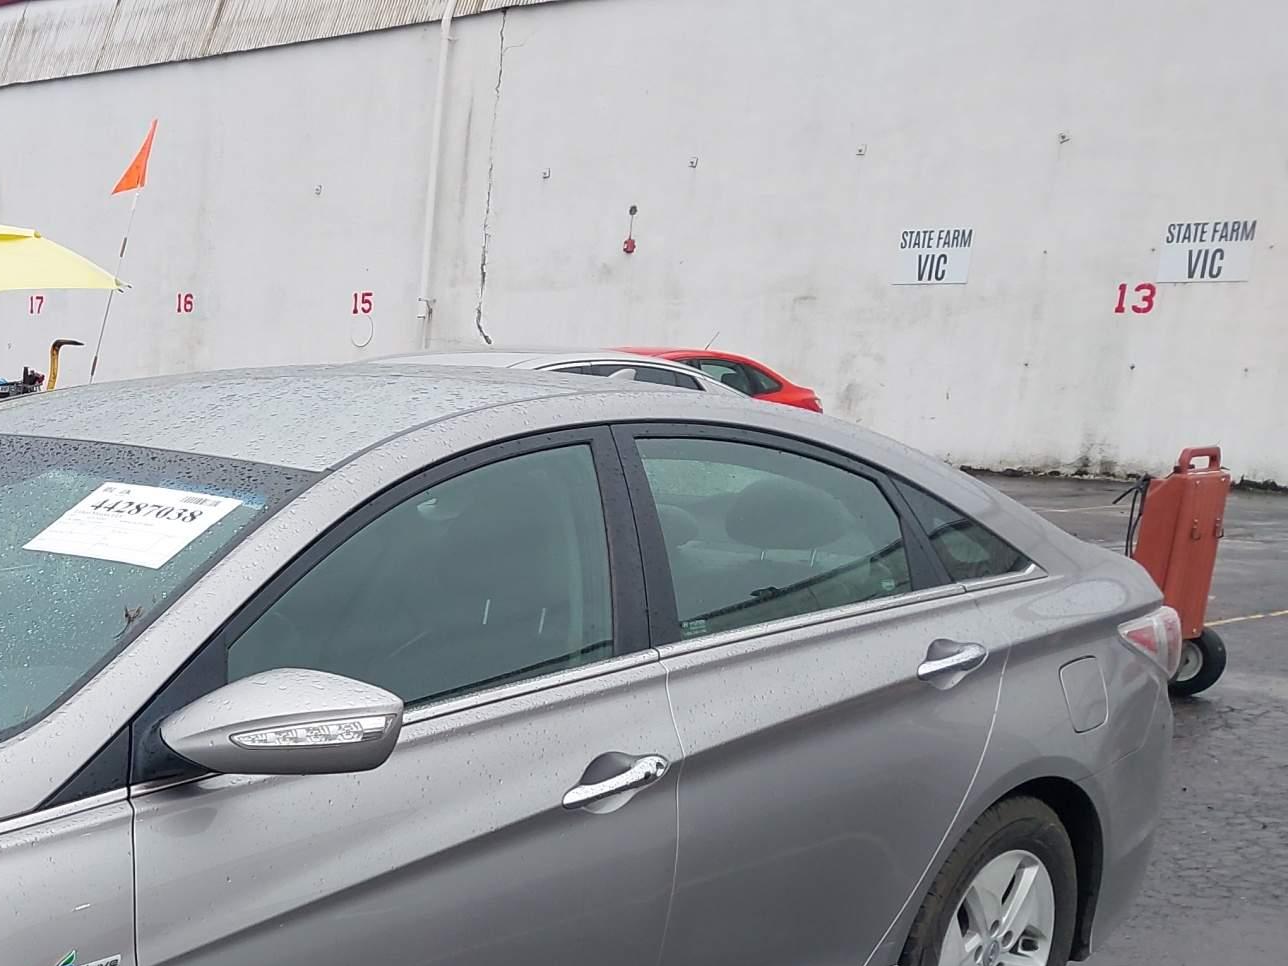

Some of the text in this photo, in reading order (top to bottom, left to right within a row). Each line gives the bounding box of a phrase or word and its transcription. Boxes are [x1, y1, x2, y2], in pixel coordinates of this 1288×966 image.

[900, 229, 973, 249] STATE FARM
[1166, 220, 1257, 244] STATE FARM
[917, 253, 948, 281] VIC
[1187, 248, 1225, 279] VIC
[29, 295, 44, 314] 17
[176, 293, 194, 313] 16
[352, 292, 373, 314] 15
[1114, 283, 1156, 314] 13
[90, 498, 205, 523] 44287038
